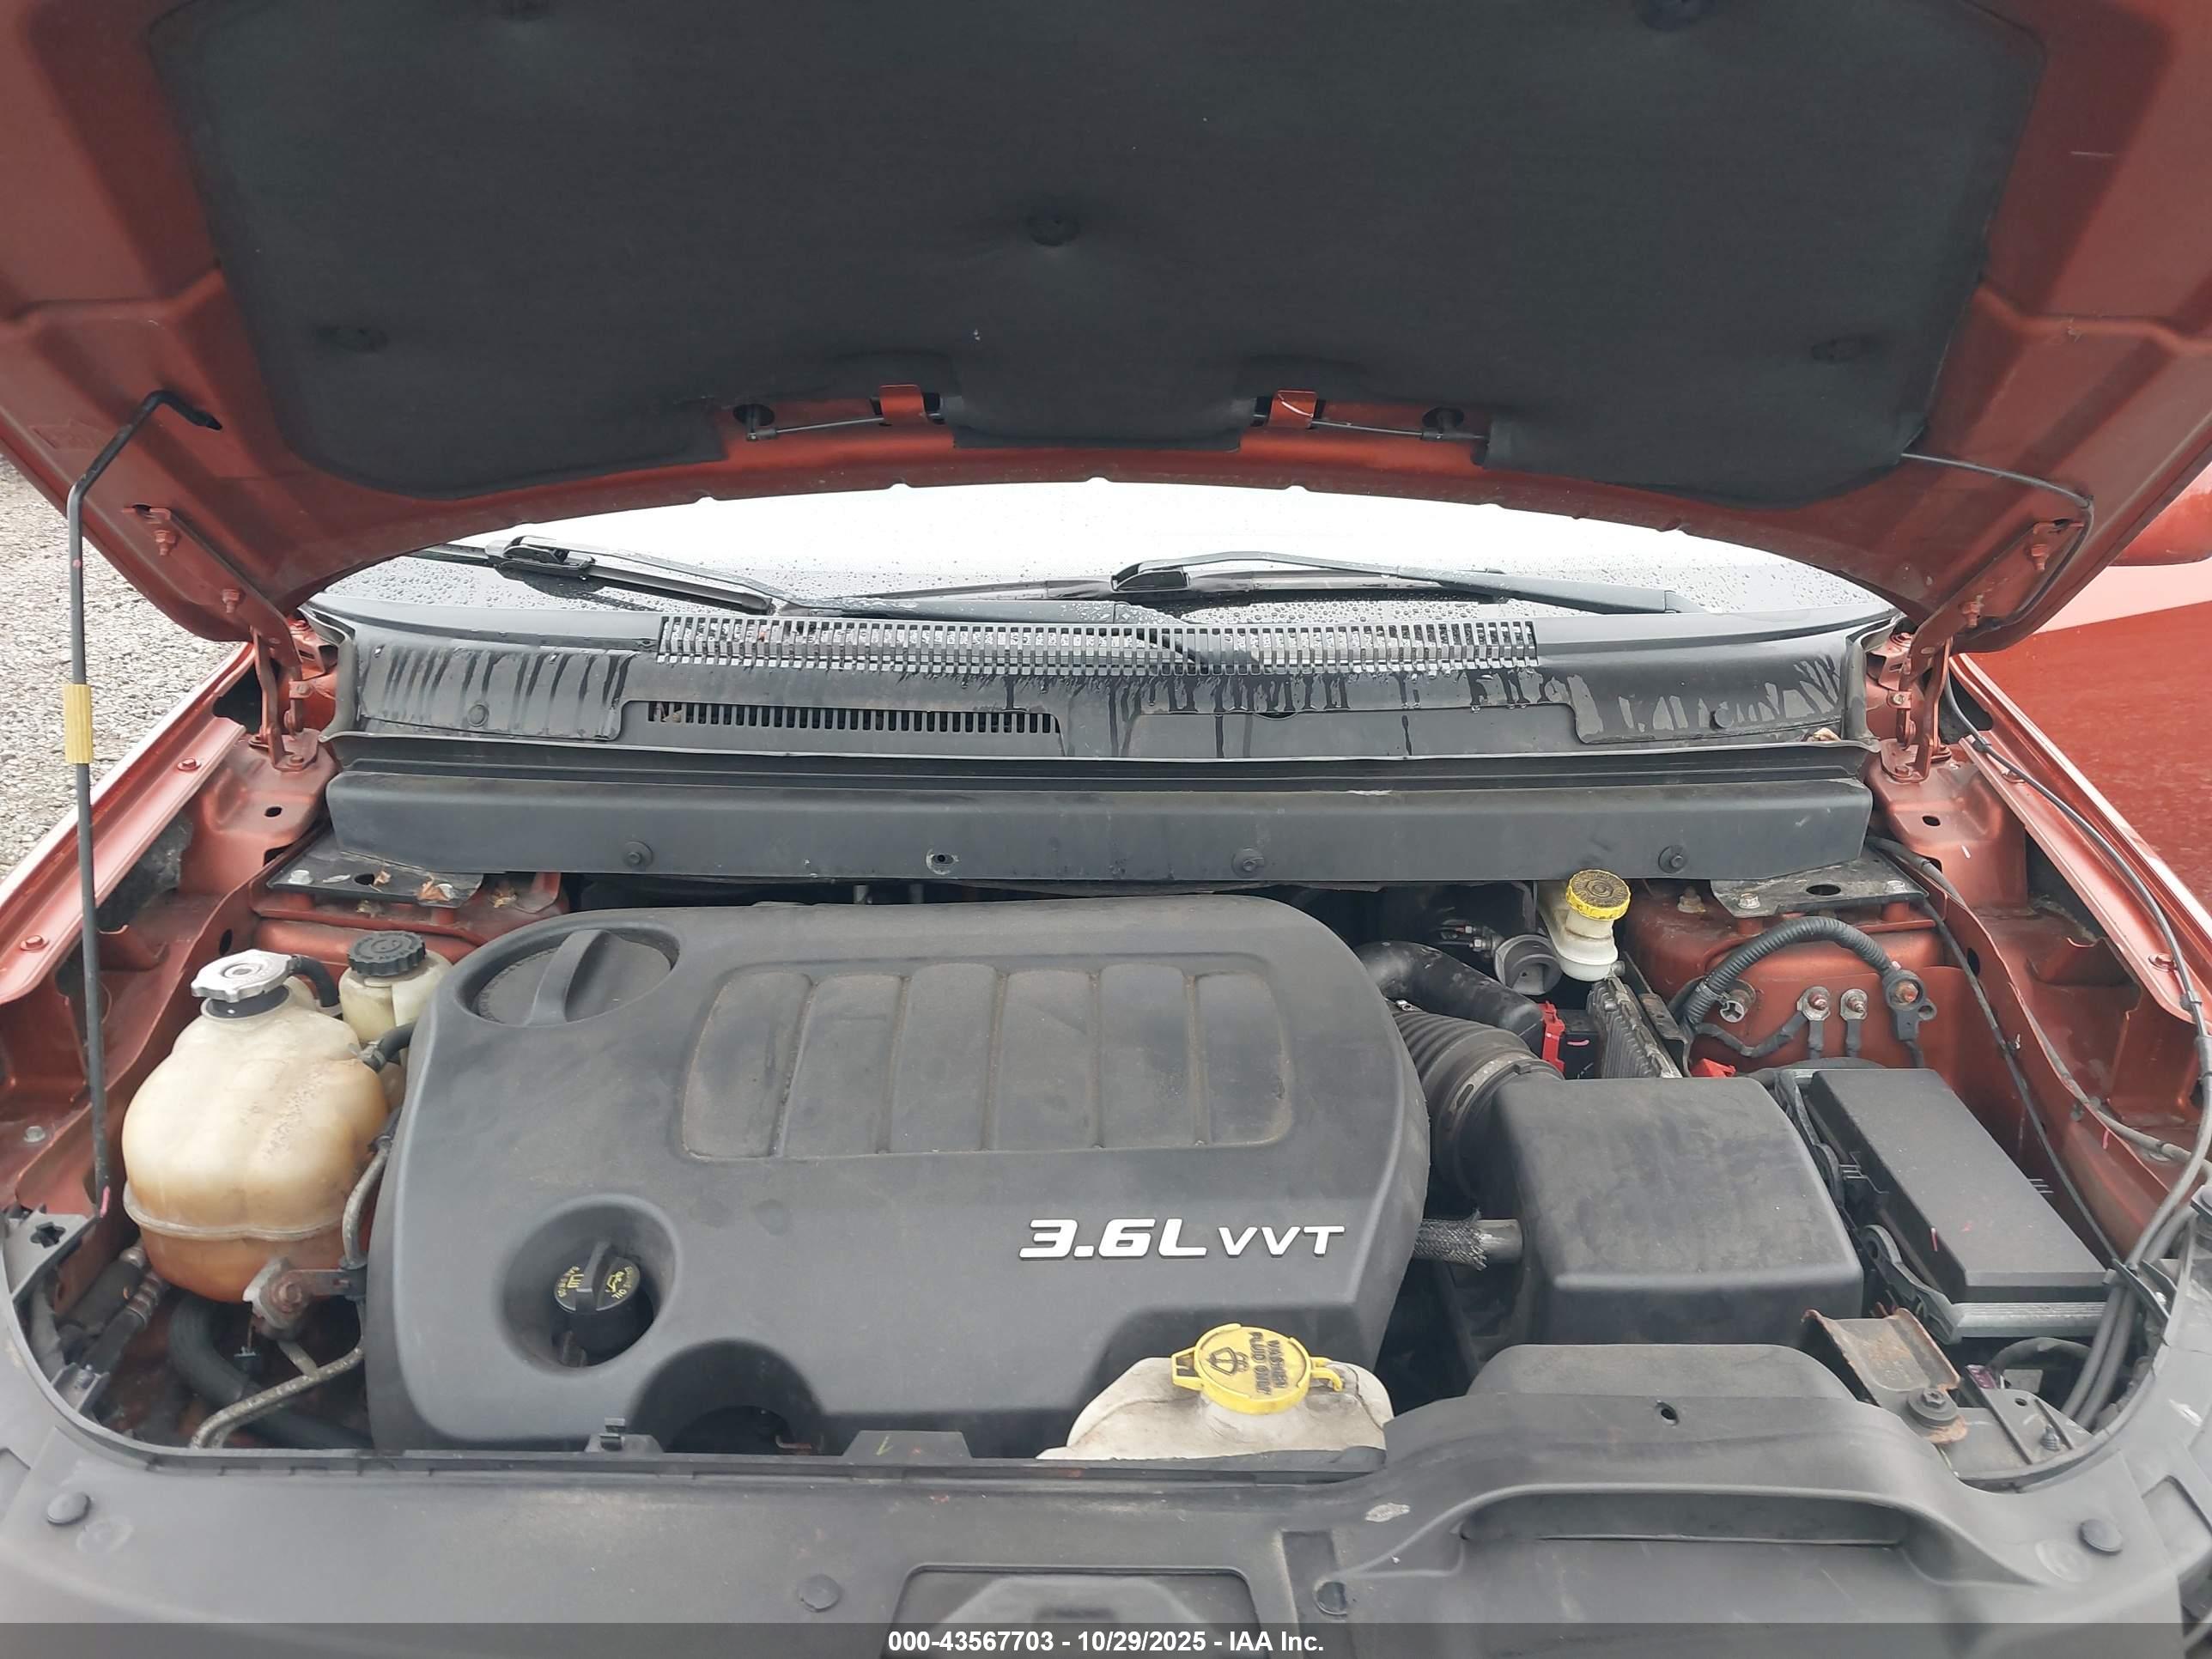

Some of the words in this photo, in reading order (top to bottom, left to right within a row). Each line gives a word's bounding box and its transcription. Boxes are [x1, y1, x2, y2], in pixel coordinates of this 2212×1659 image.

[1019, 1218, 1207, 1259] 3.6L
[1218, 1225, 1346, 1256] VVT
[1249, 1332, 1267, 1362] FLUID
[1268, 1340, 1287, 1388] WASHER
[1254, 1364, 1271, 1395] ONLY
